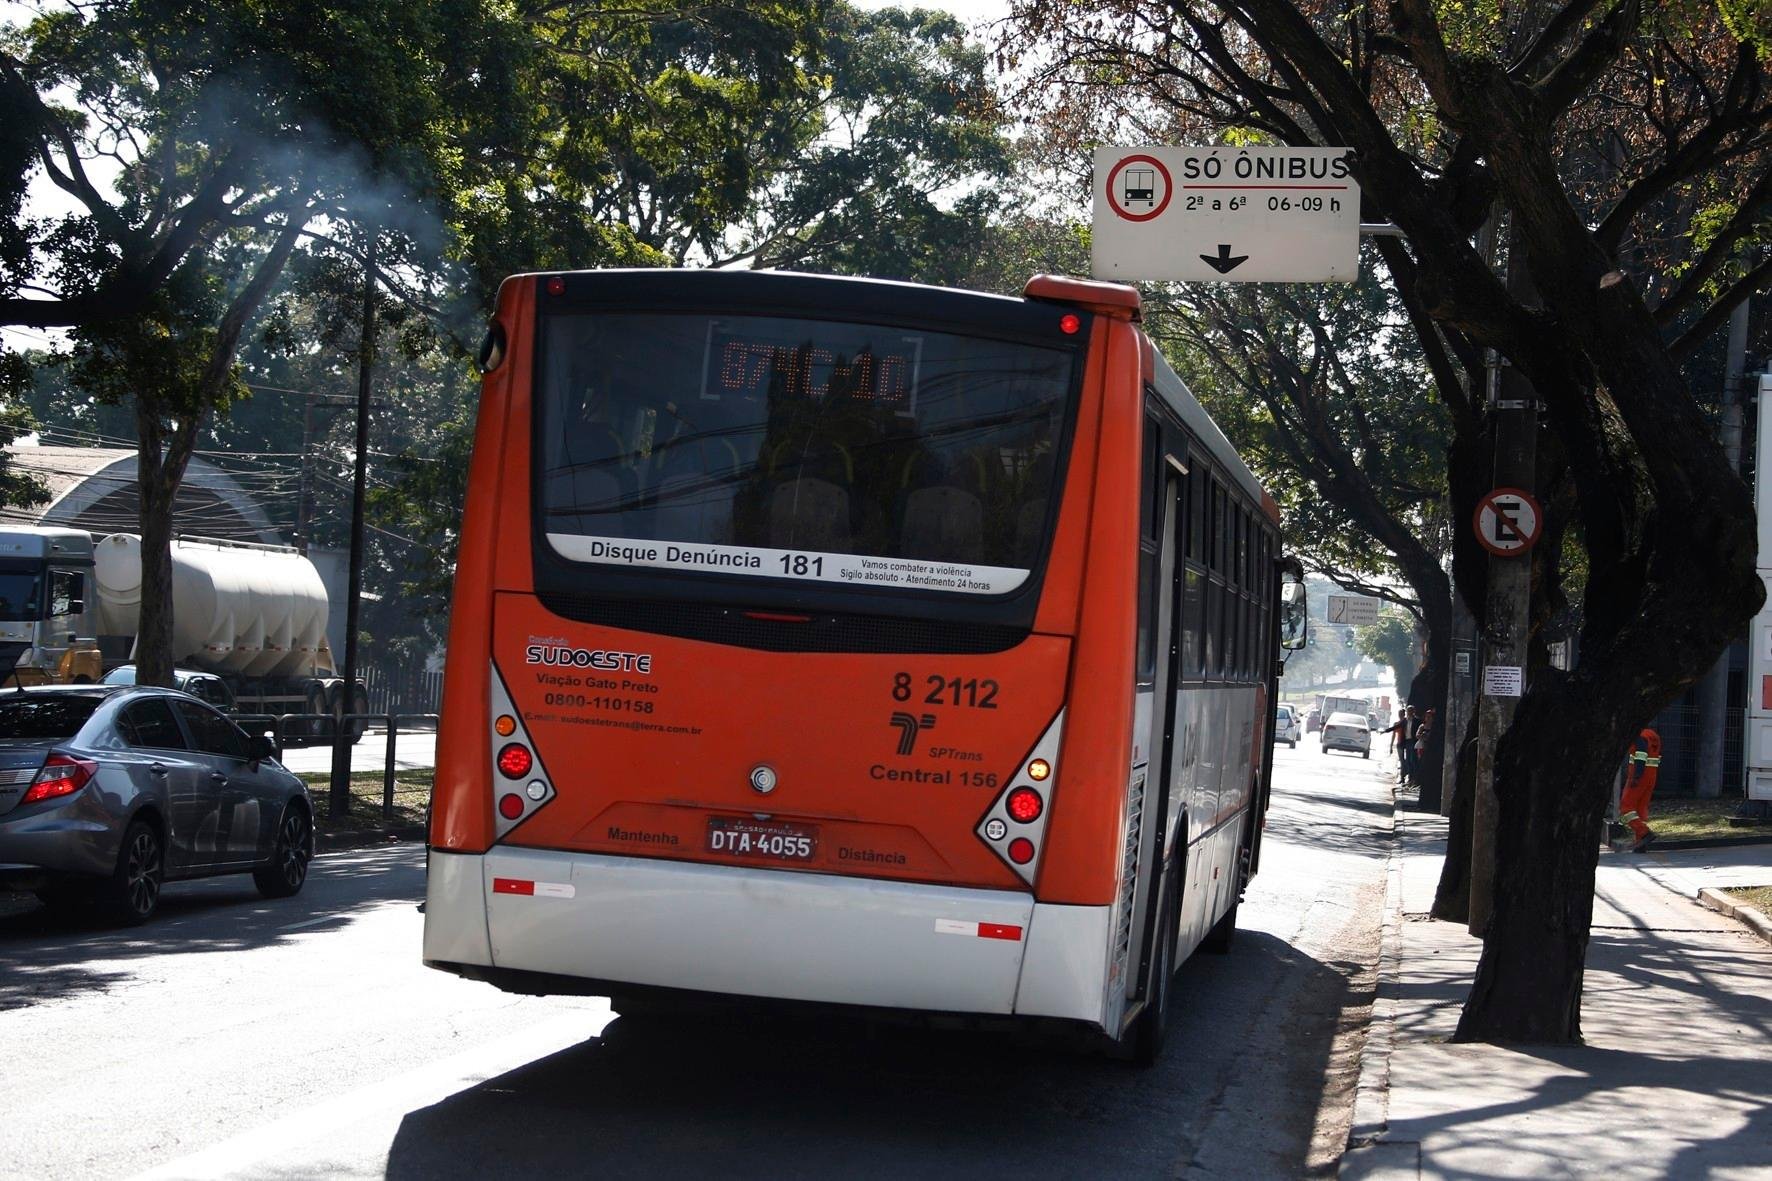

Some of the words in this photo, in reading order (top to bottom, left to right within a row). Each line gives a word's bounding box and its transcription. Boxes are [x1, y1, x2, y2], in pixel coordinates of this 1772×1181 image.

[1183, 150, 1221, 179] SÓ
[1234, 150, 1348, 180] ÔNIBUS
[1212, 200, 1221, 210] a
[1268, 196, 1322, 211] 06-09
[1331, 197, 1340, 211] h
[720, 341, 905, 400] 874C-10
[591, 541, 657, 563] Disque
[666, 546, 761, 568] Denúncia
[779, 554, 823, 577] 181
[862, 559, 888, 570] Vamos
[890, 562, 927, 574] combater
[936, 566, 971, 577] violência
[840, 568, 863, 580] Sigilo
[864, 571, 898, 582] absoluto
[905, 575, 955, 588] Atendimento
[957, 579, 966, 588] 24
[968, 581, 990, 590] horas
[526, 645, 651, 674] SUDOESTE
[536, 673, 581, 688] Viação
[585, 678, 617, 690] Gato
[622, 680, 658, 694] Preto
[892, 672, 912, 702] 8
[924, 675, 999, 709] 2112
[545, 693, 654, 714] 0800-110158
[928, 747, 983, 762] SPTrans
[870, 764, 950, 784] Central
[960, 772, 997, 788] 156
[608, 827, 679, 845] Mantenha
[839, 847, 906, 864] Distância
